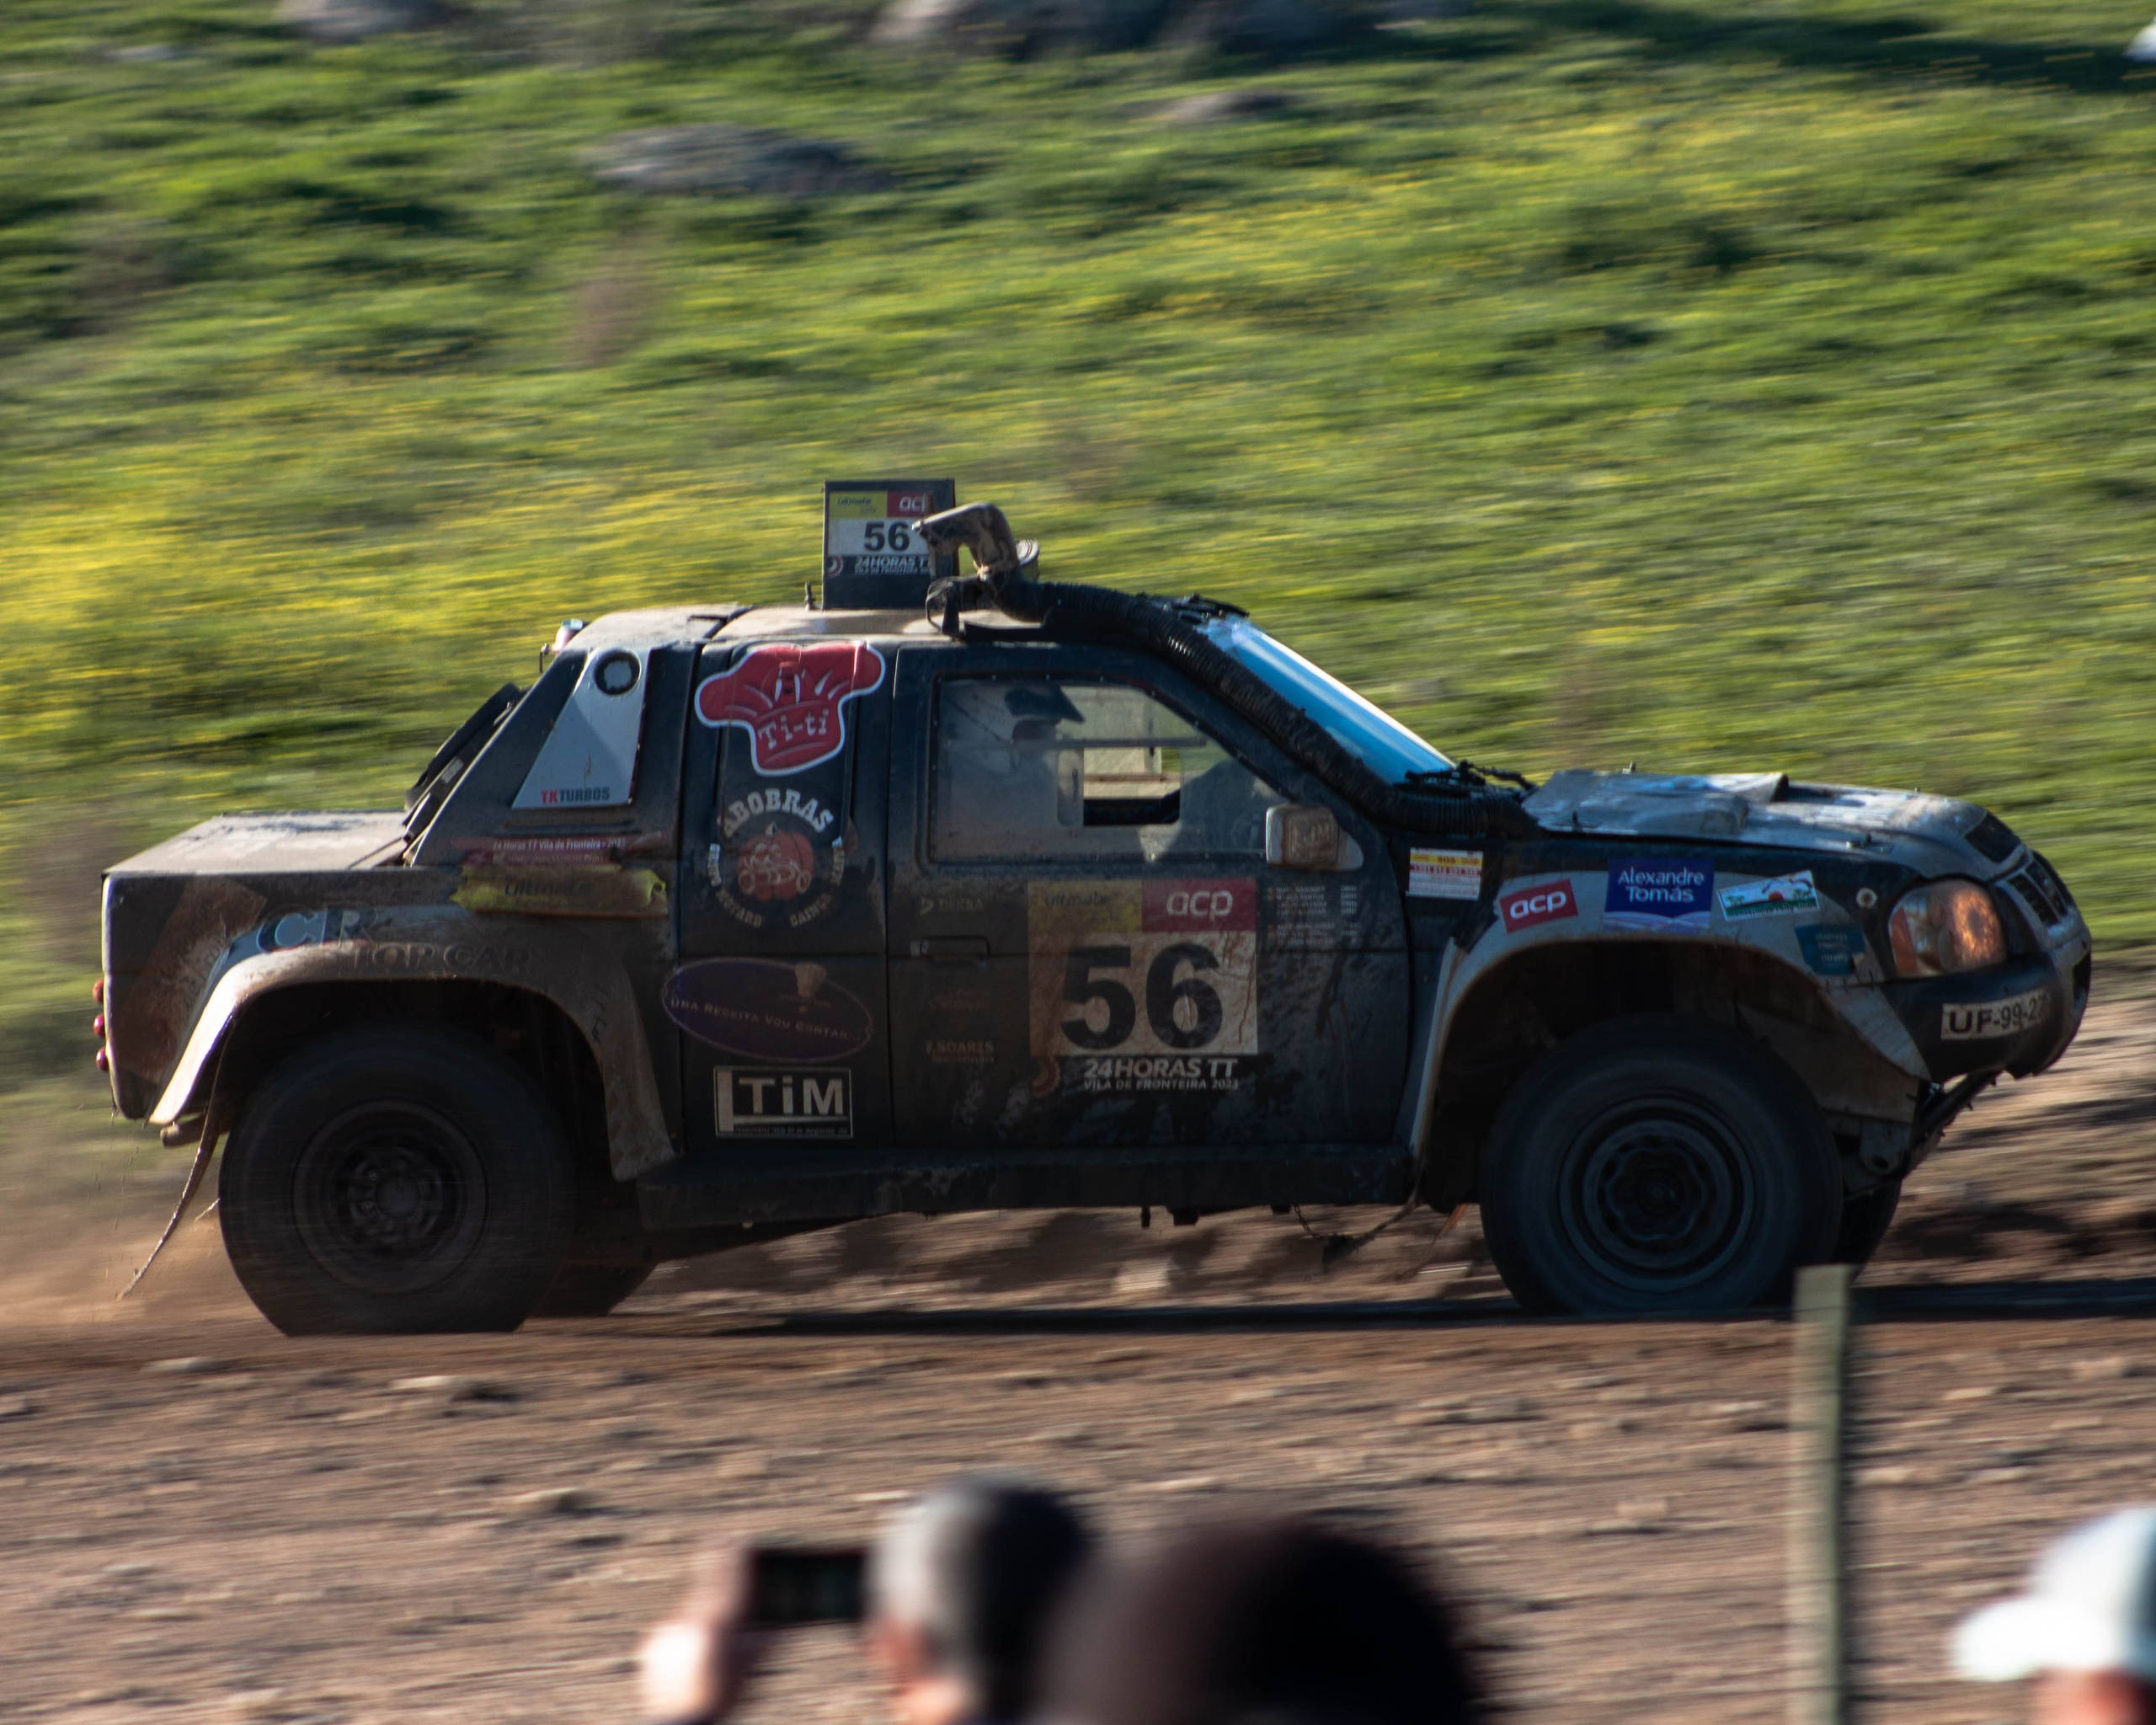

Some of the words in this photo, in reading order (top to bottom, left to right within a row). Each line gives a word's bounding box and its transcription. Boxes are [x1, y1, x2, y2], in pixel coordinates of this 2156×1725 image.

[863, 521, 910, 551] 56
[758, 708, 829, 750] Ti-ti
[1618, 867, 1705, 886] Alexandre
[1166, 889, 1234, 921] acp
[1509, 890, 1566, 920] acp
[1625, 885, 1694, 904] Tomás
[1059, 943, 1222, 1049] 56
[1207, 1057, 1239, 1078] TT
[1083, 1077, 1112, 1091] VILA
[1116, 1078, 1132, 1090] DE
[1136, 1077, 1207, 1090] FRONTEIRA
